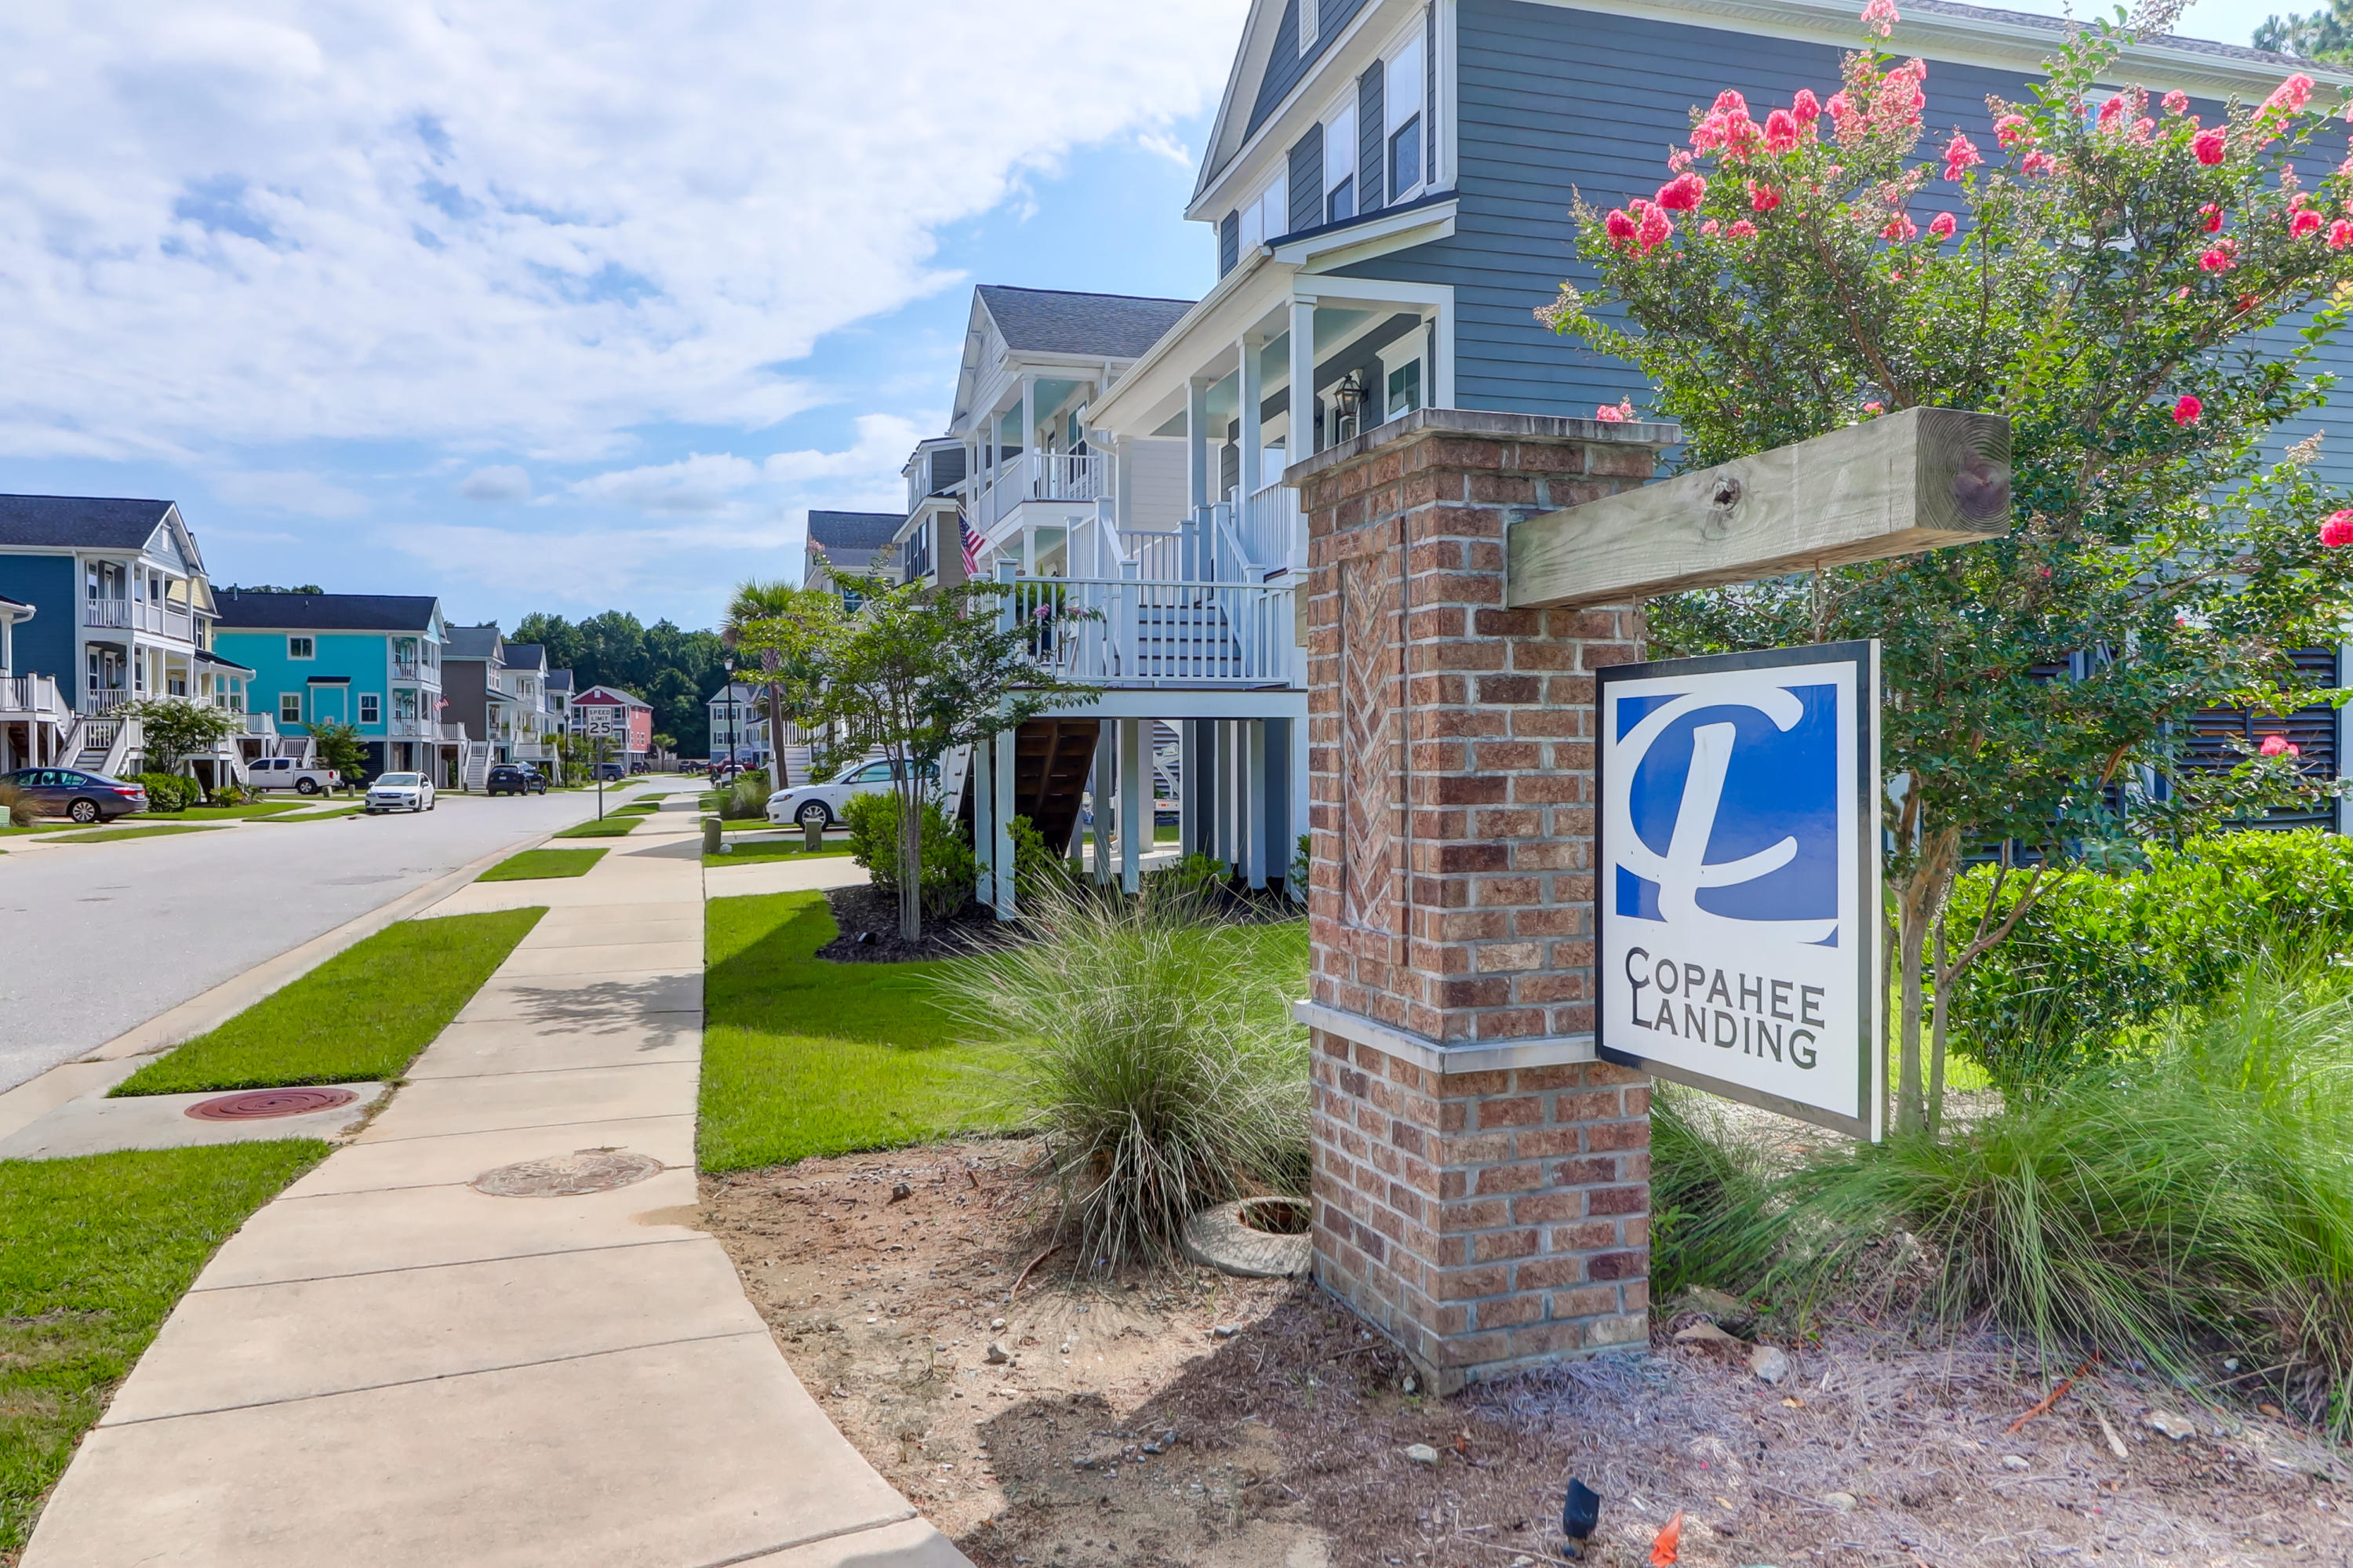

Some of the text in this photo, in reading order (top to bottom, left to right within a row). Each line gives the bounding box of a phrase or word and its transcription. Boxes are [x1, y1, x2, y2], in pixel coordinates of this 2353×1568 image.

[590, 722, 610, 733] 25
[1625, 946, 1825, 1029] COPAHEE
[1631, 986, 1817, 1070] LANDING
